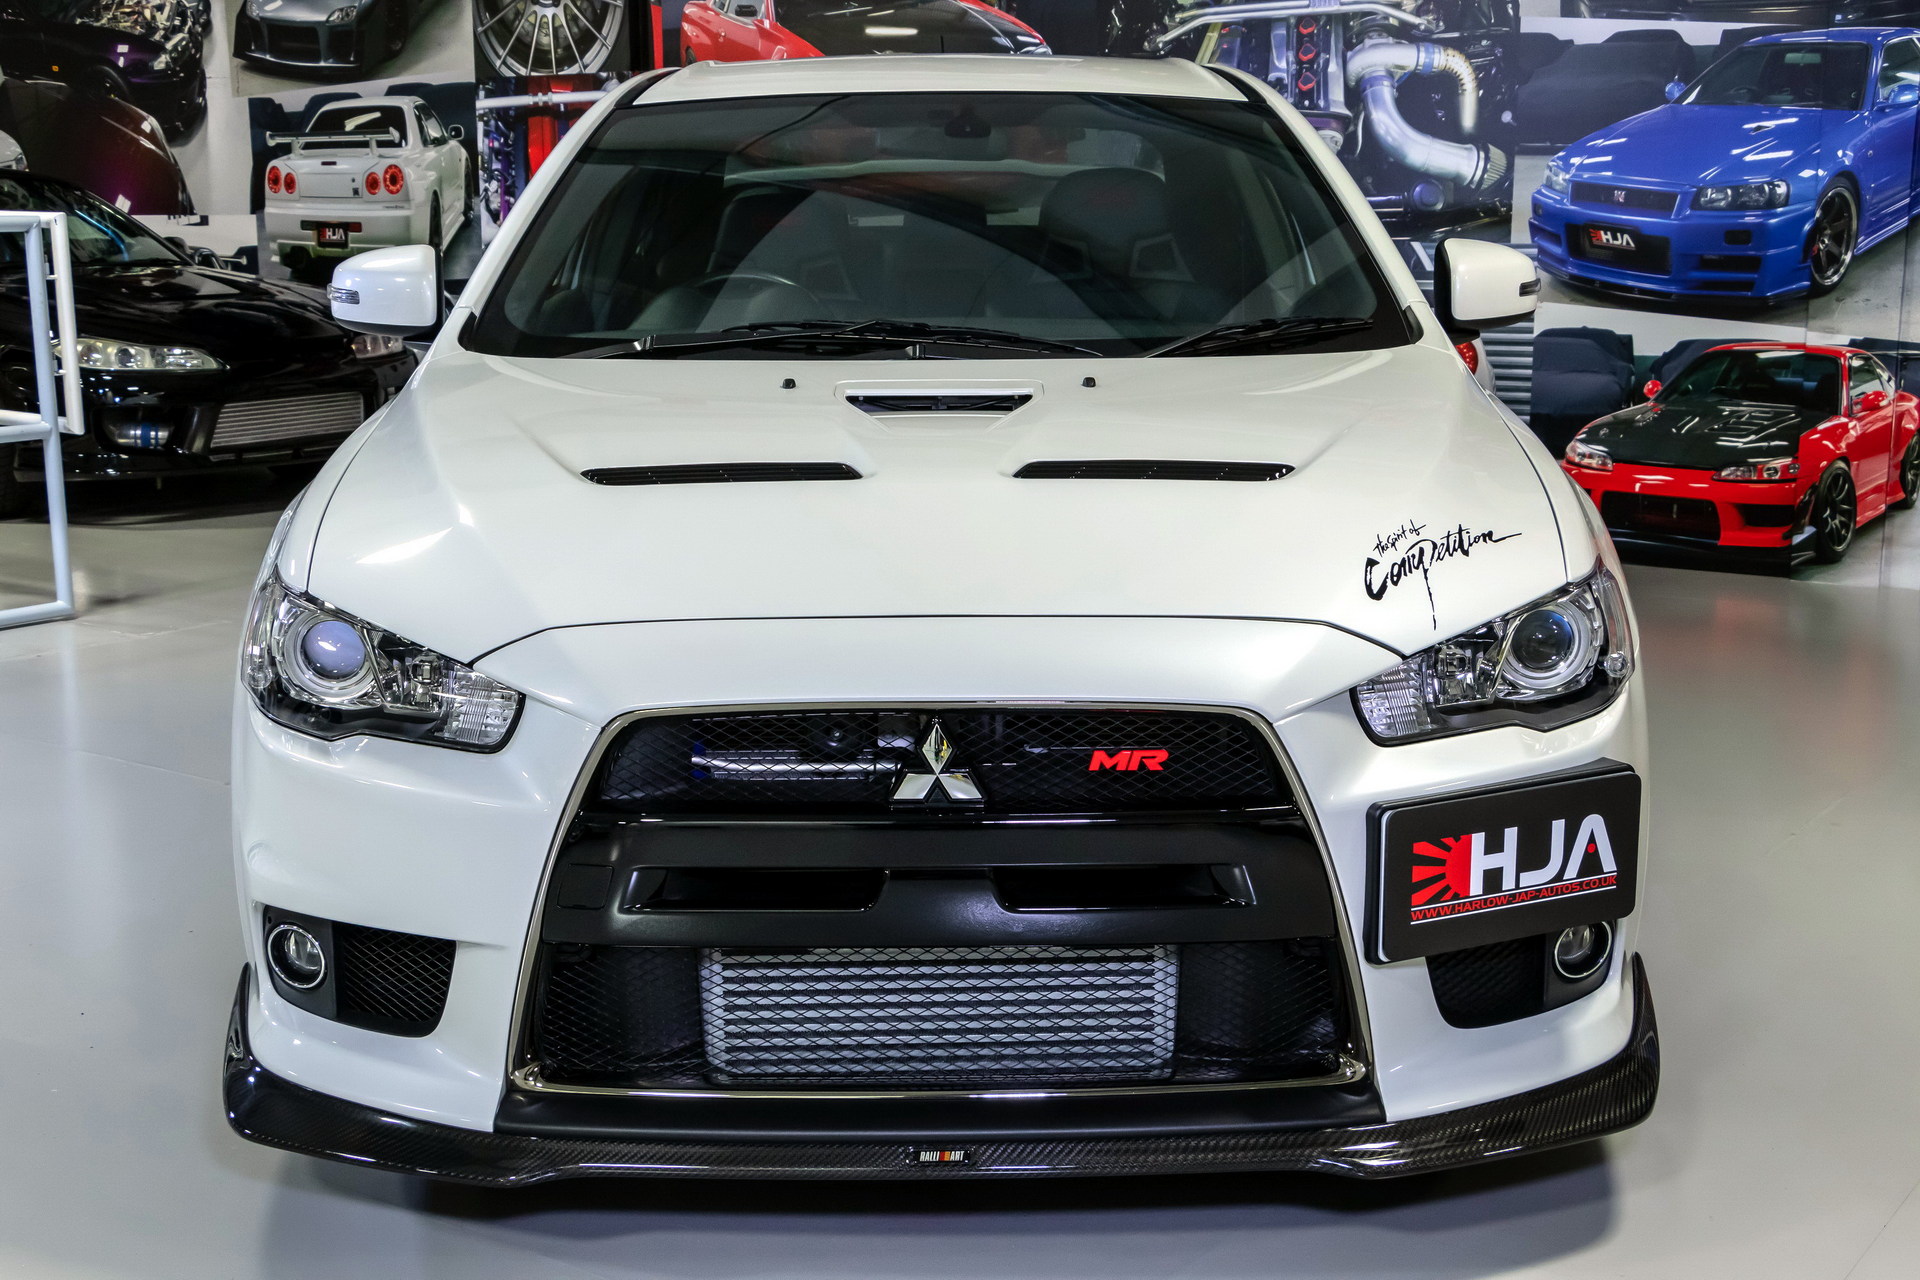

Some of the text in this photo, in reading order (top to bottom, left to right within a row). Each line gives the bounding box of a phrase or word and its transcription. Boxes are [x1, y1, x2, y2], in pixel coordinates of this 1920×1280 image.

[325, 227, 345, 240] HJA
[1600, 230, 1636, 248] HJA
[1409, 519, 1426, 536] of
[1088, 749, 1169, 771] MR
[1470, 813, 1617, 896] HJA
[1411, 874, 1617, 921] WWW.HARLOW-JAP-AUTOS.CO.UK
